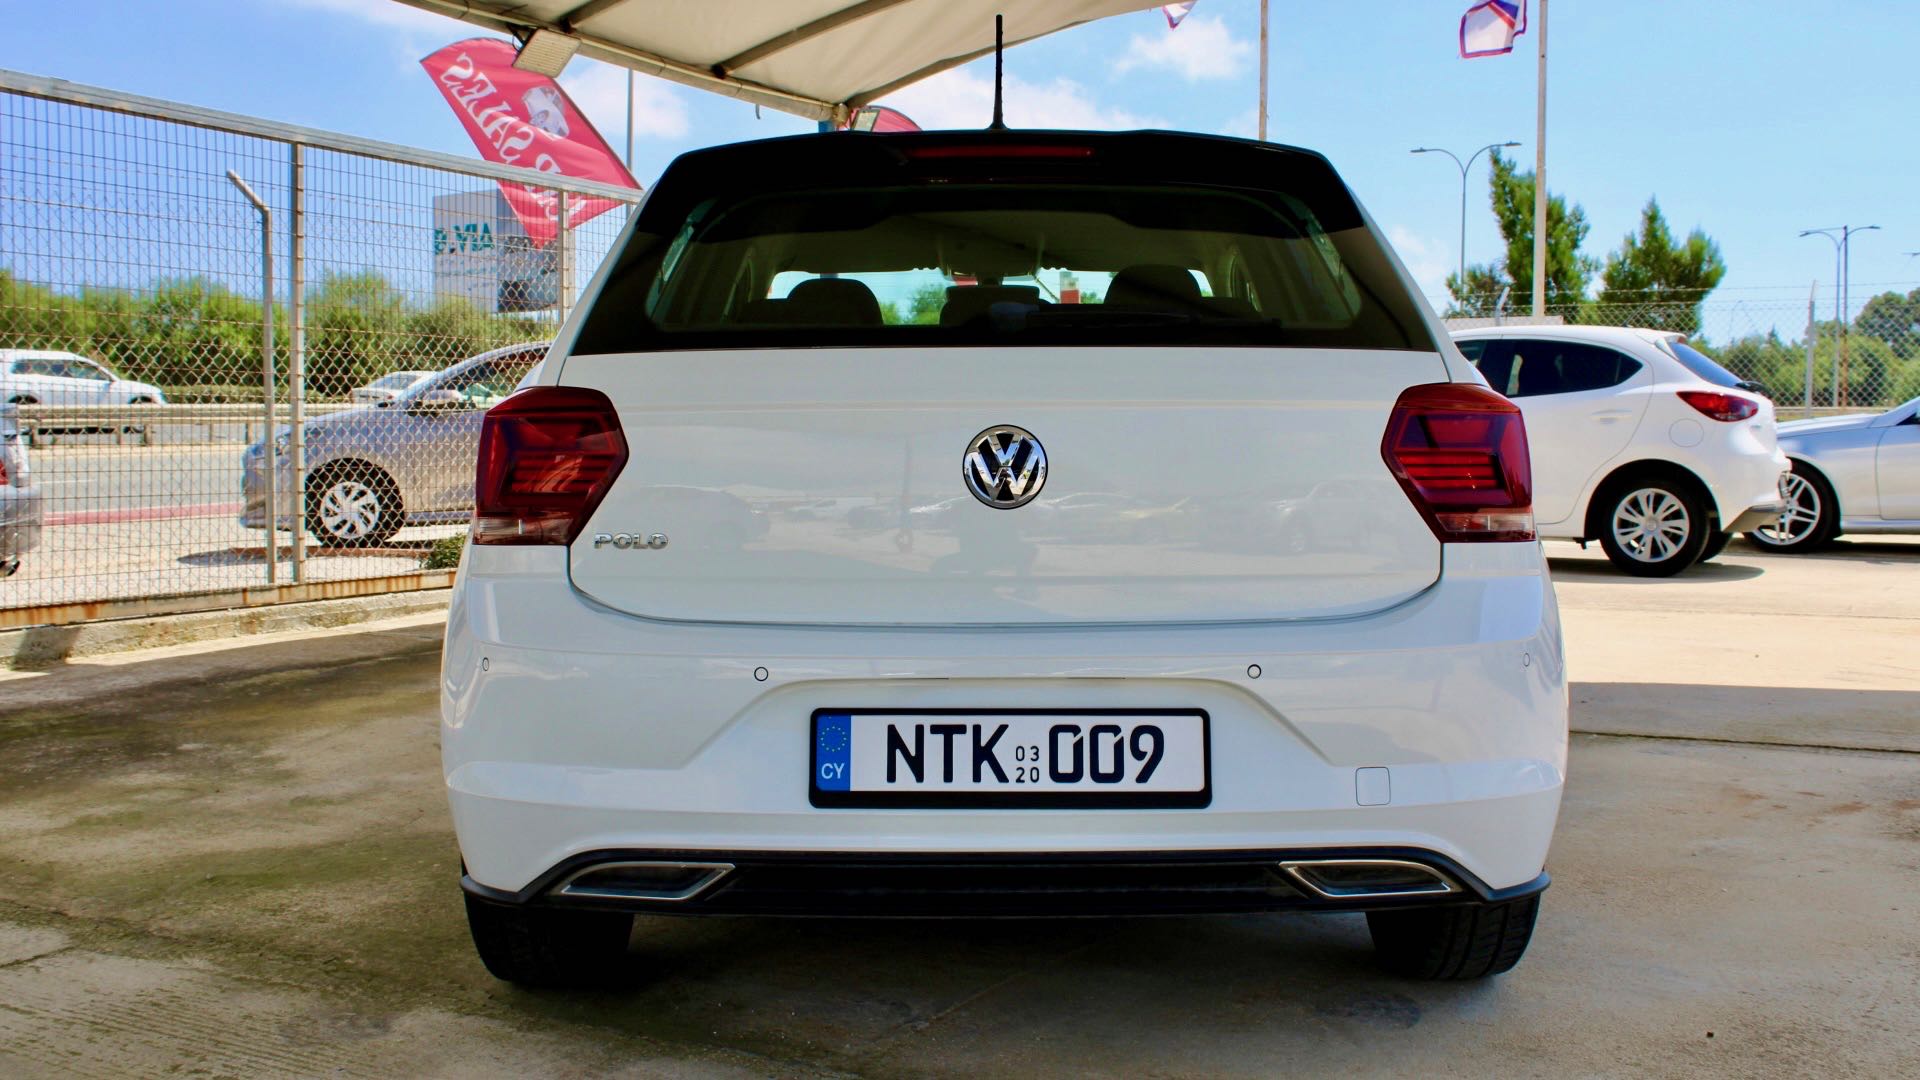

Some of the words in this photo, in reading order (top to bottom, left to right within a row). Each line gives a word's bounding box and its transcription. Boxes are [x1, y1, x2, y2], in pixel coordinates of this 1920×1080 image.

[965, 427, 1045, 505] VW
[594, 532, 668, 550] POLO
[886, 723, 1010, 784] NTK
[1048, 724, 1165, 784] 009
[1015, 745, 1040, 762] 03
[821, 763, 845, 780] CY
[1015, 766, 1040, 784] 20
